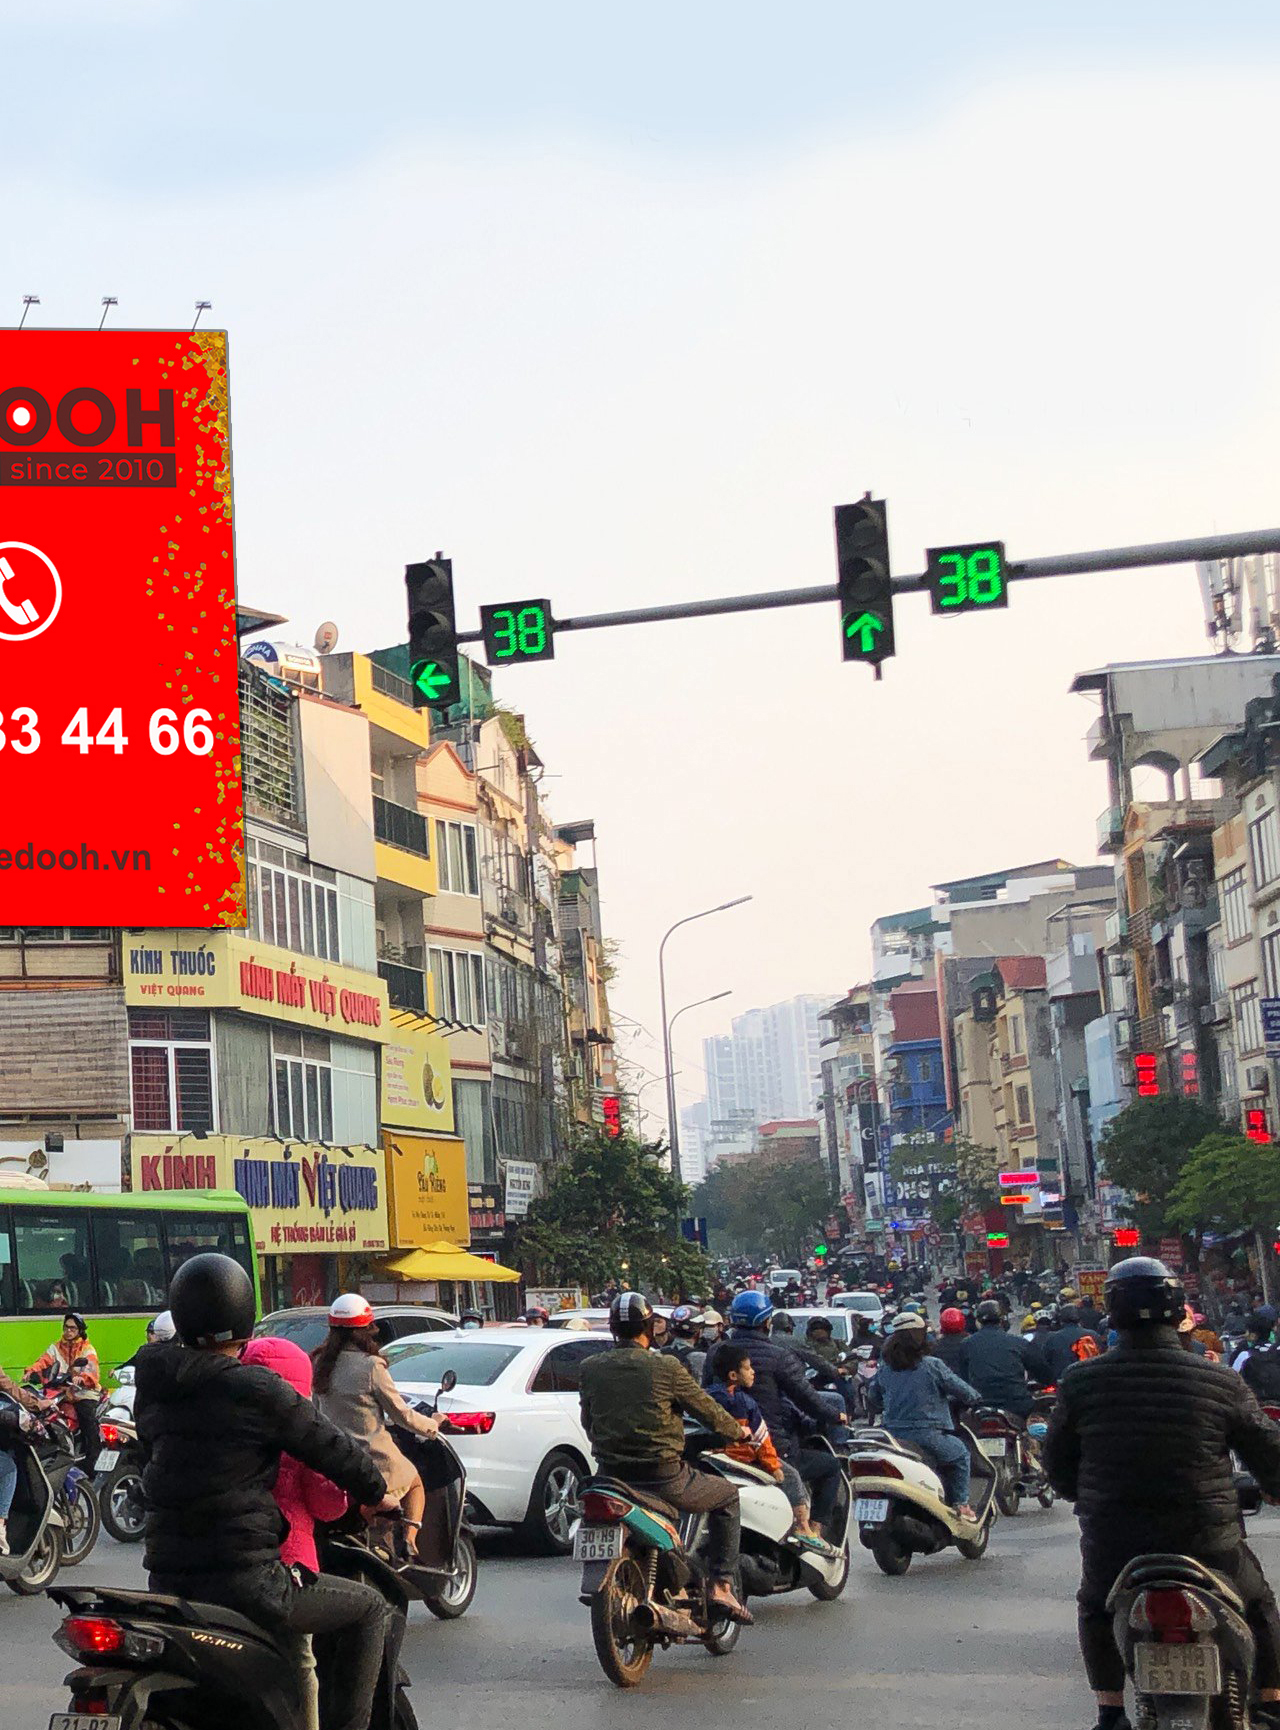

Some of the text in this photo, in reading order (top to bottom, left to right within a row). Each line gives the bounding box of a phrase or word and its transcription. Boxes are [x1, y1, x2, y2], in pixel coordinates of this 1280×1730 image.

[10, 458, 164, 481] since 2010
[939, 550, 1003, 606] 38
[494, 606, 546, 658] 38
[61, 707, 129, 755] 44
[148, 708, 215, 756] 66
[130, 943, 216, 976] KÍNH THUỐC
[140, 983, 206, 997] VIỆT QUANG
[239, 955, 274, 1003] KÍNH
[308, 974, 338, 1022] VIỆT
[339, 988, 382, 1028] QUANG
[141, 1146, 217, 1192] KÍNH
[580, 1544, 614, 1558] 8056
